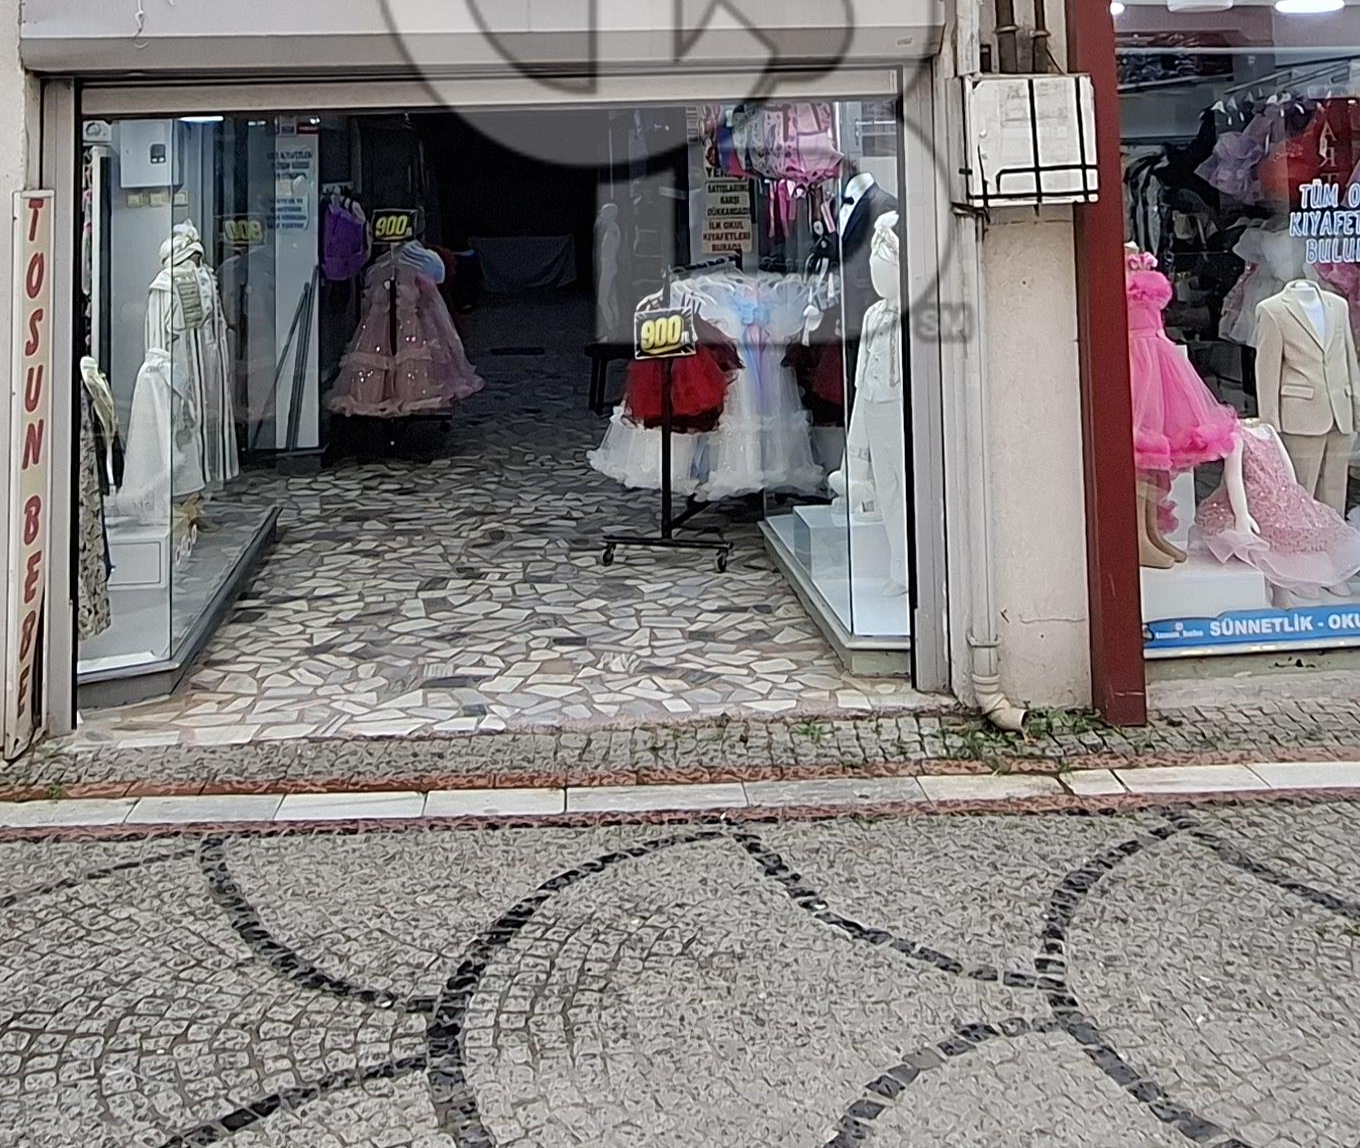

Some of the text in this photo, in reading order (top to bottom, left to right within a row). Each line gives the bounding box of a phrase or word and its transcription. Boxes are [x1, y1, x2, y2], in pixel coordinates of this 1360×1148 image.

[1299, 178, 1339, 209] TÜM
[375, 214, 408, 238] 900
[21, 198, 45, 471] TOSUN
[640, 314, 685, 351] 900
[1209, 613, 1314, 637] SÜNNETLİK
